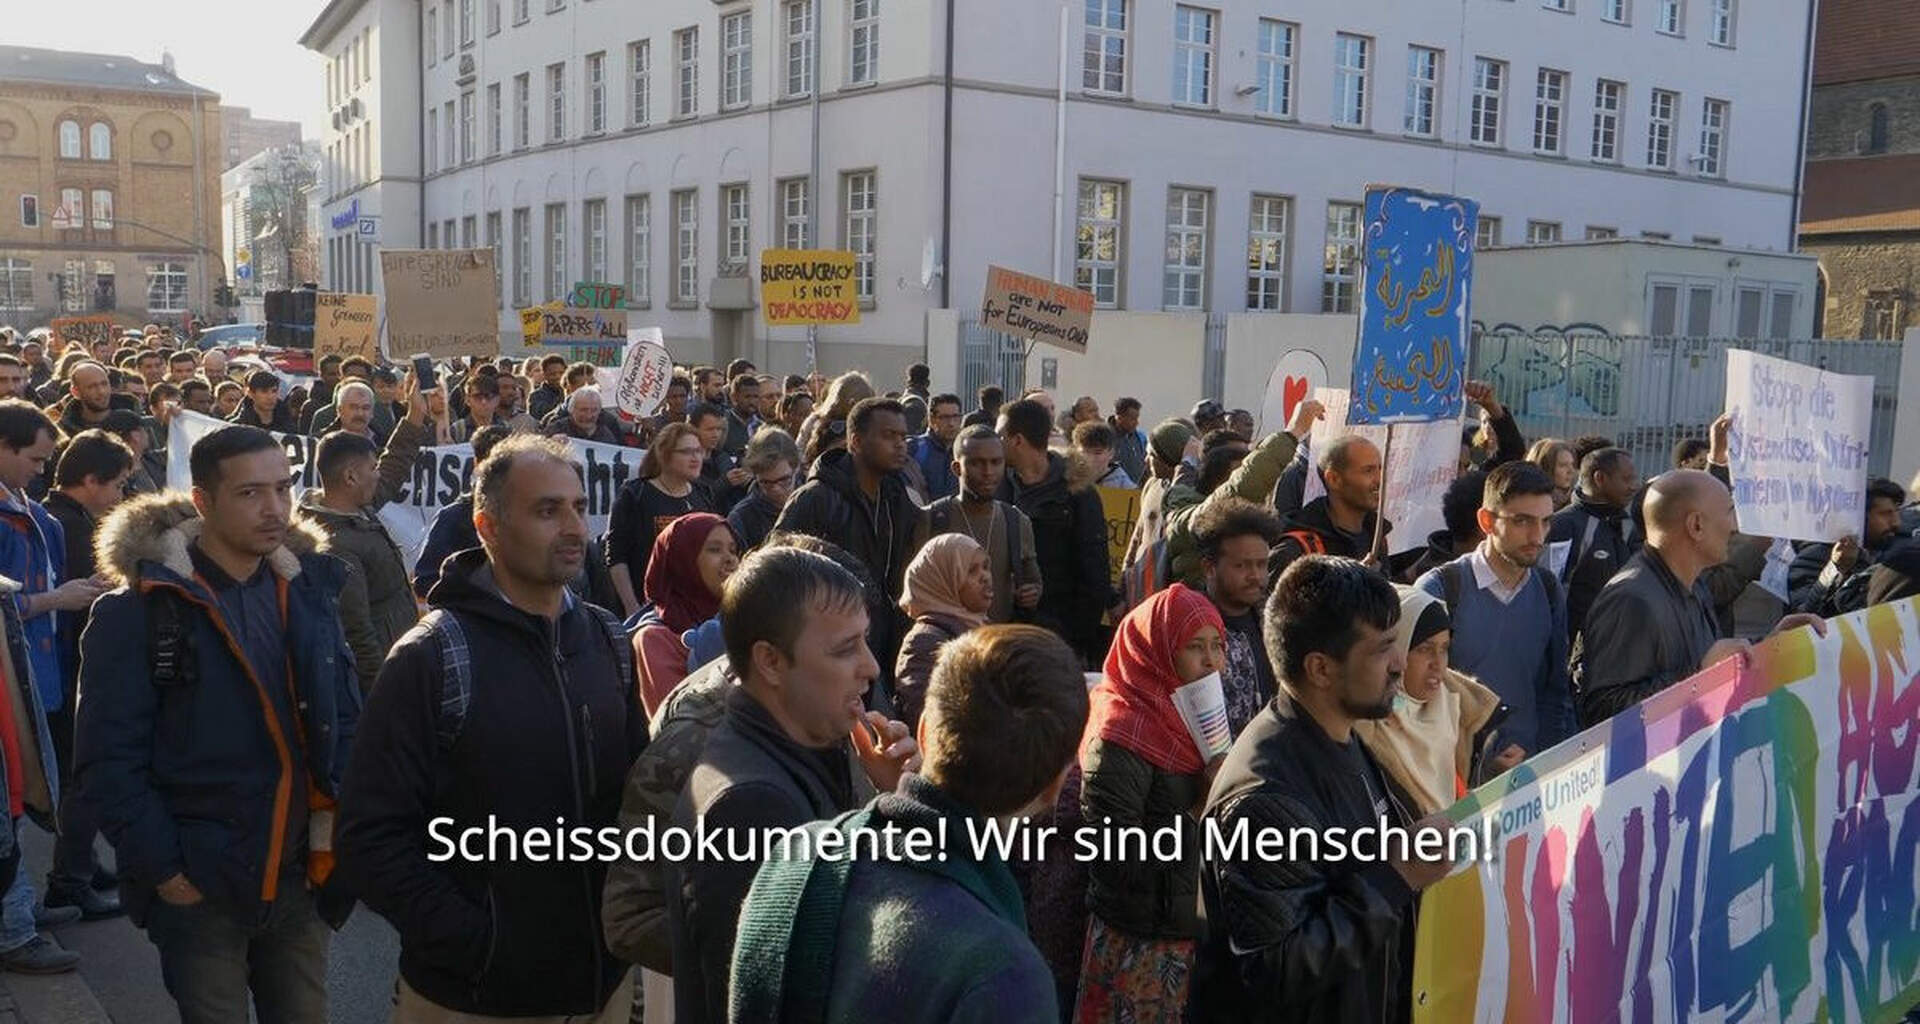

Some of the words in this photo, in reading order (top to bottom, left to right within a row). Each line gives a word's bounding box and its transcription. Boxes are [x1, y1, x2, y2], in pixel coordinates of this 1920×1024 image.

[761, 262, 853, 284] BUREAUCRACY
[576, 285, 624, 309] STOP
[792, 286, 808, 299] IS
[813, 284, 842, 299] NOT
[1008, 292, 1033, 307] are
[768, 302, 852, 321] DEMOCRACY
[983, 299, 1005, 324] for
[543, 313, 593, 336] PAPERS
[600, 322, 627, 339] ALL
[1753, 362, 1802, 426] Stopp
